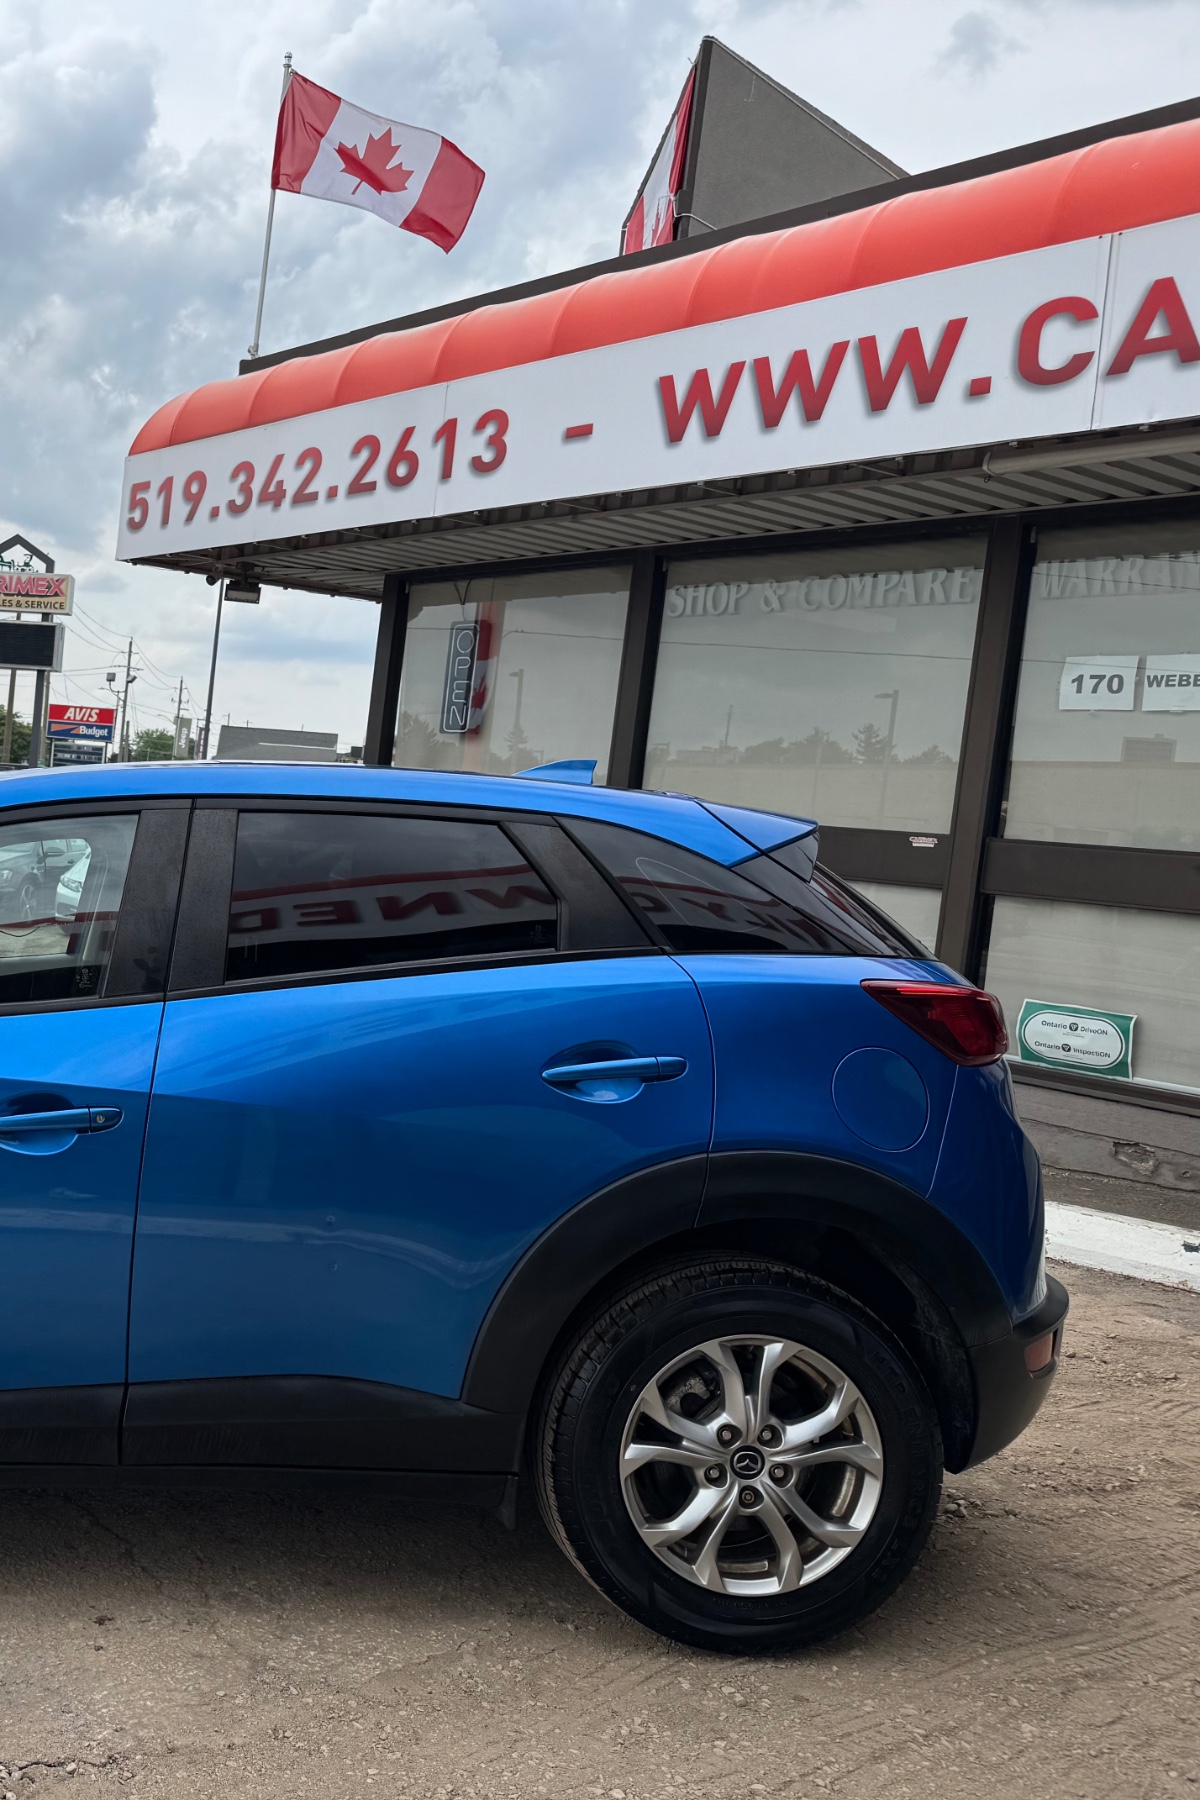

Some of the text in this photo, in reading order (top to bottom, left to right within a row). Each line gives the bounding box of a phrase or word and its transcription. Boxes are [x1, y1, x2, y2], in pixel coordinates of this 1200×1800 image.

[127, 408, 510, 530] 519.342.2613
[658, 276, 1200, 445] WWW.CA
[667, 565, 976, 618] SHOP & COMPARE
[15, 599, 23, 608] &
[24, 600, 65, 610] SERVICE
[449, 630, 474, 726] OPEN
[1071, 674, 1125, 694] 170
[64, 707, 100, 722] AVIS
[79, 725, 108, 738] Budget
[179, 727, 189, 749] Jeep
[1041, 1020, 1068, 1030] Ontario
[1034, 1040, 1061, 1051] Ontario
